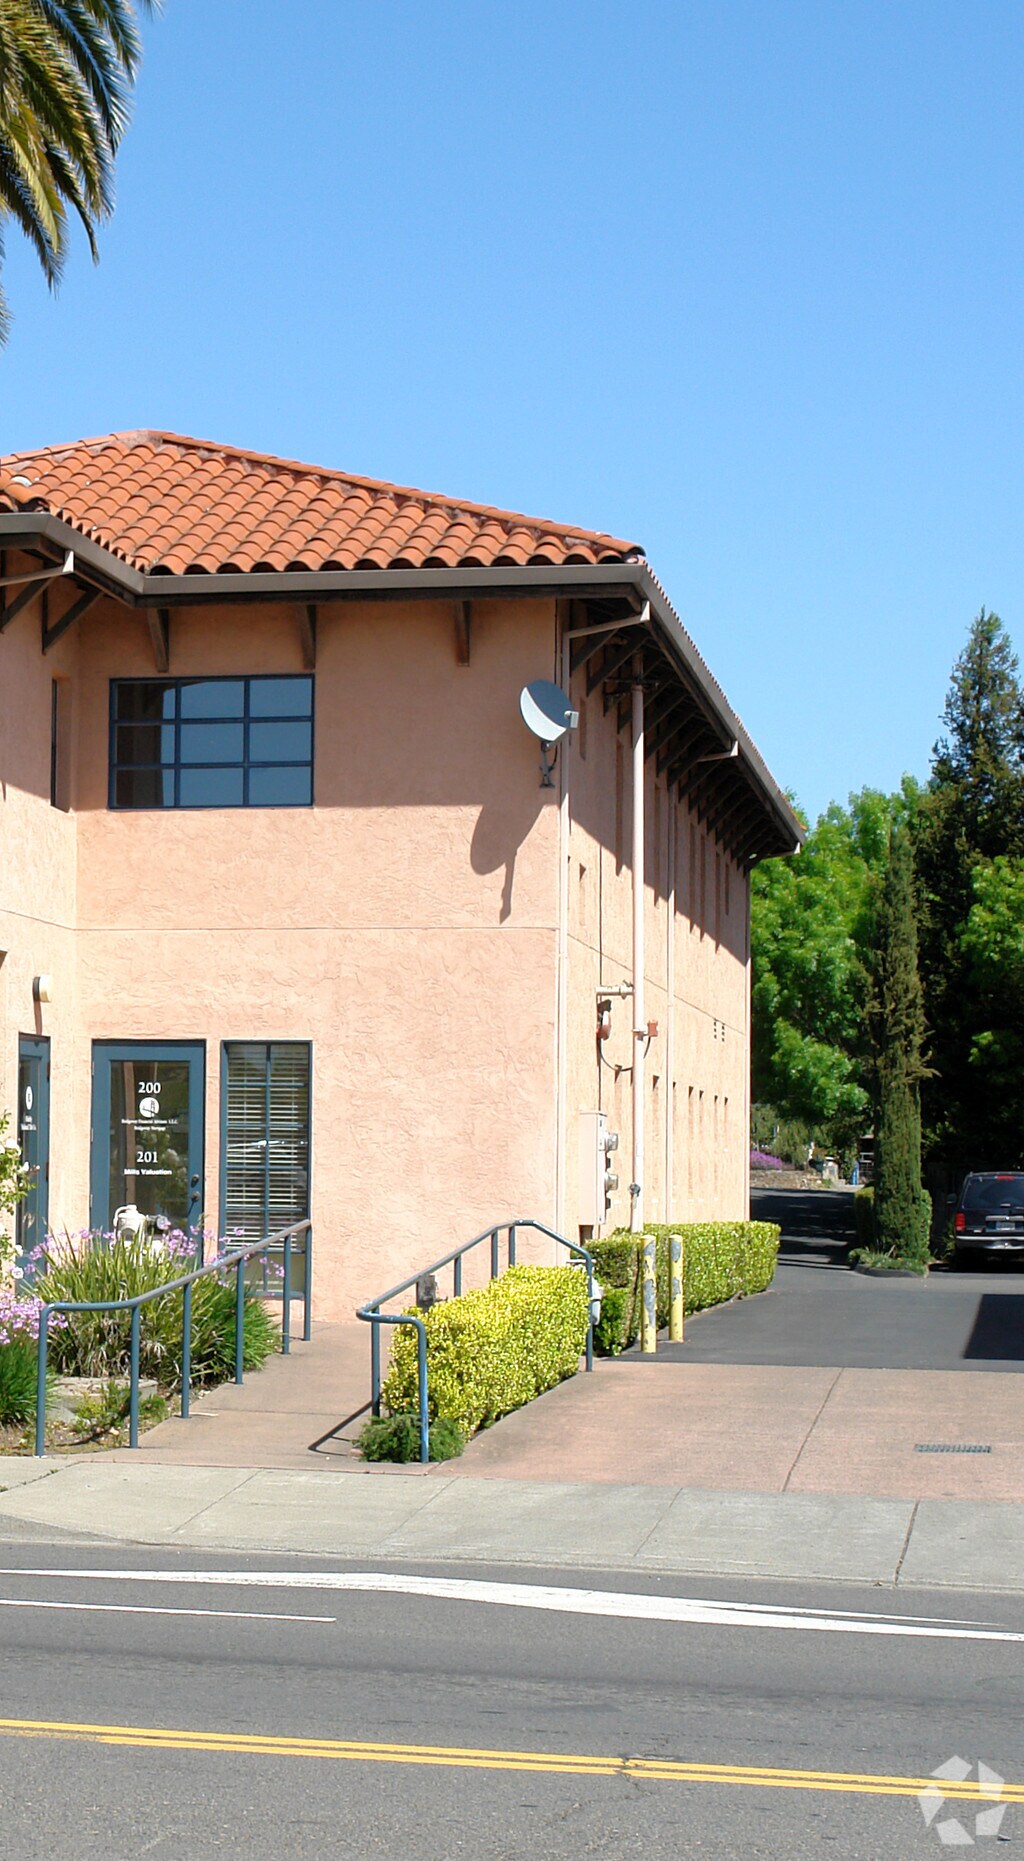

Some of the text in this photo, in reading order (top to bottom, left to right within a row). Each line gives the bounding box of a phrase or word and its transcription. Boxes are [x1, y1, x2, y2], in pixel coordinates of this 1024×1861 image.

[137, 1081, 162, 1094] 200
[136, 1151, 158, 1163] 201
[140, 1168, 173, 1176] Valuation
